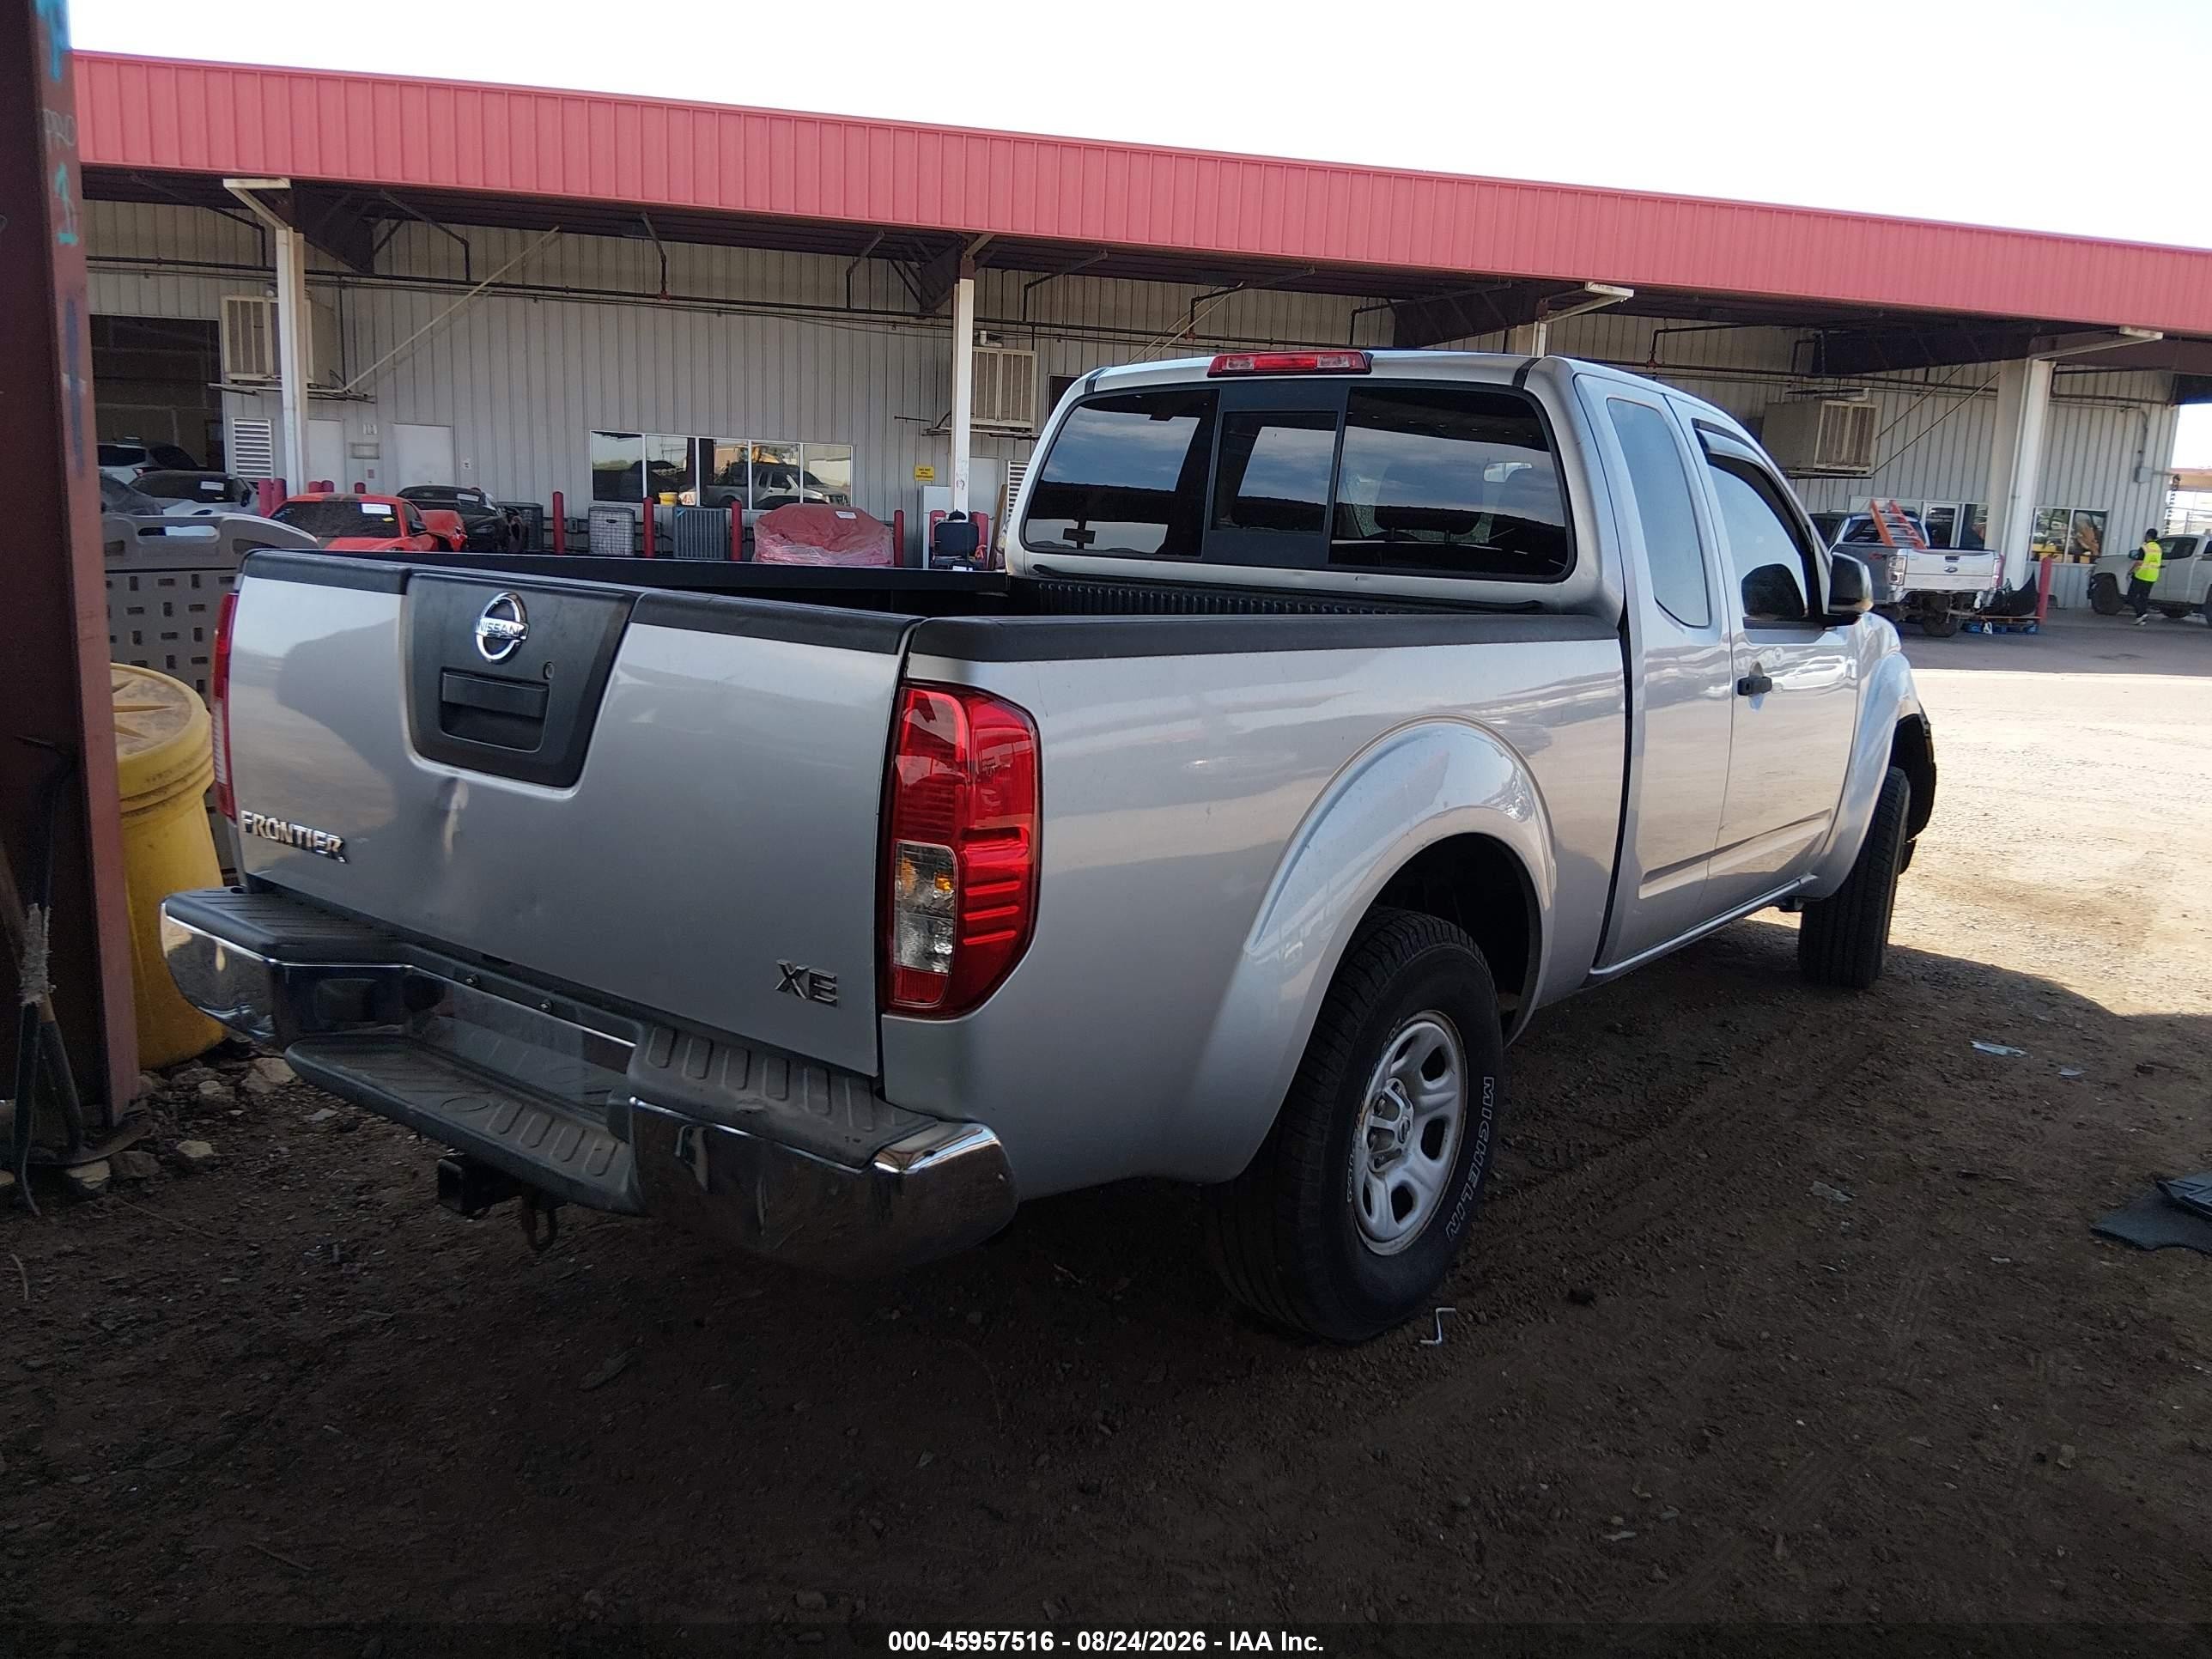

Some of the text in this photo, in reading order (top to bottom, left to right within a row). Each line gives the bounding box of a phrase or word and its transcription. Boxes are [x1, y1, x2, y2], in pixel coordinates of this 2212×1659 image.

[480, 620, 520, 635] NISSAN
[240, 810, 346, 863] FRONTIER
[775, 959, 838, 1007] XE
[1445, 1076, 1495, 1243] MICHELIN
